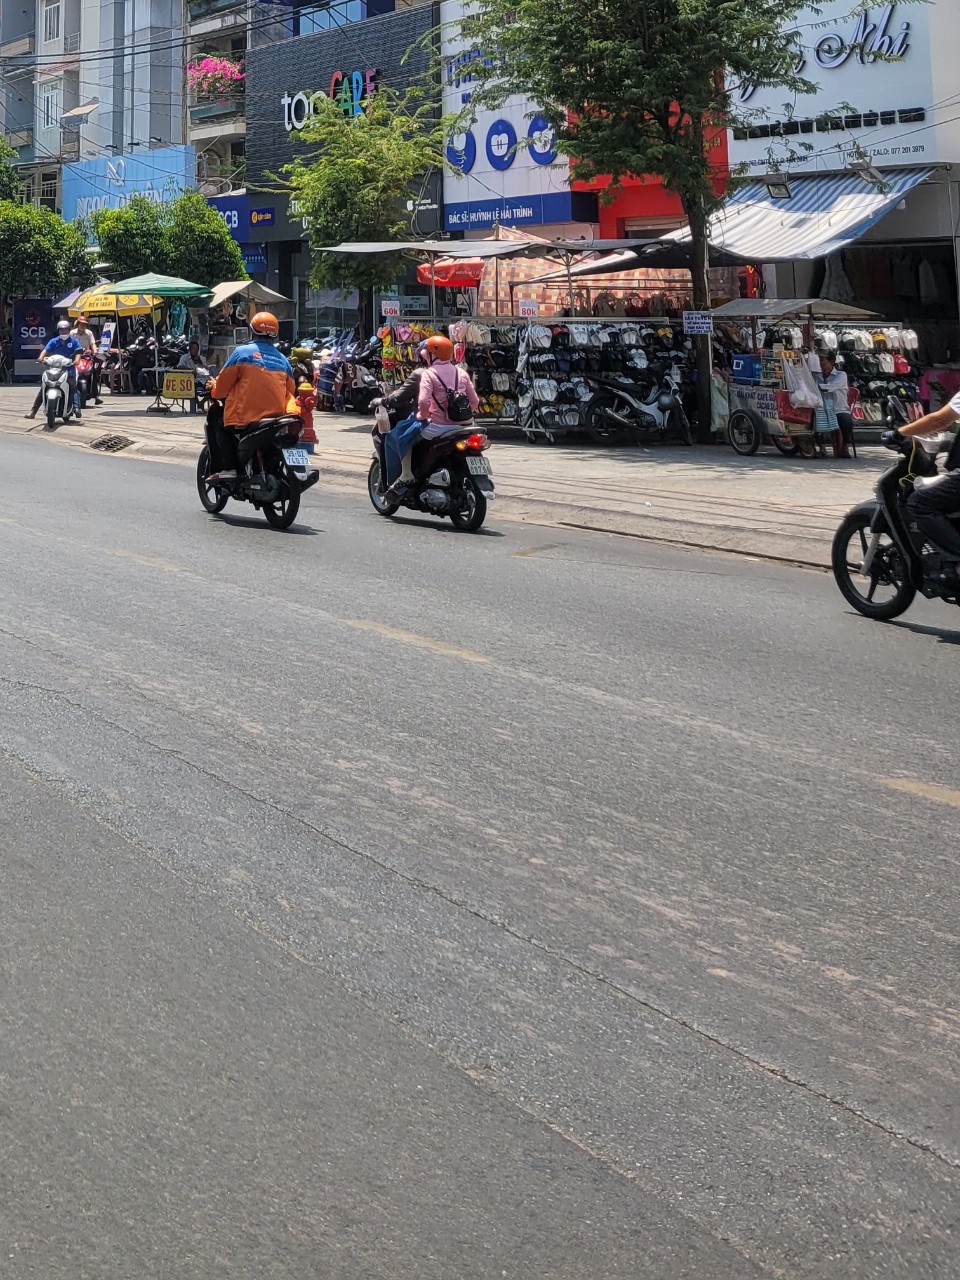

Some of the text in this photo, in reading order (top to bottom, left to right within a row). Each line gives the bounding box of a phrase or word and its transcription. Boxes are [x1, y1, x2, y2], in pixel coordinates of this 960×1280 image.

[891, 146, 901, 154] 077
[448, 211, 461, 224] BÁC
[470, 209, 492, 222] HUỲNH
[492, 207, 500, 220] LÊ
[501, 205, 512, 220] HẢI
[512, 205, 533, 219] TRÌNH
[383, 307, 398, 315] 60k
[521, 307, 537, 316] 80k
[20, 326, 47, 338] SCB
[179, 376, 193, 392] SỐ
